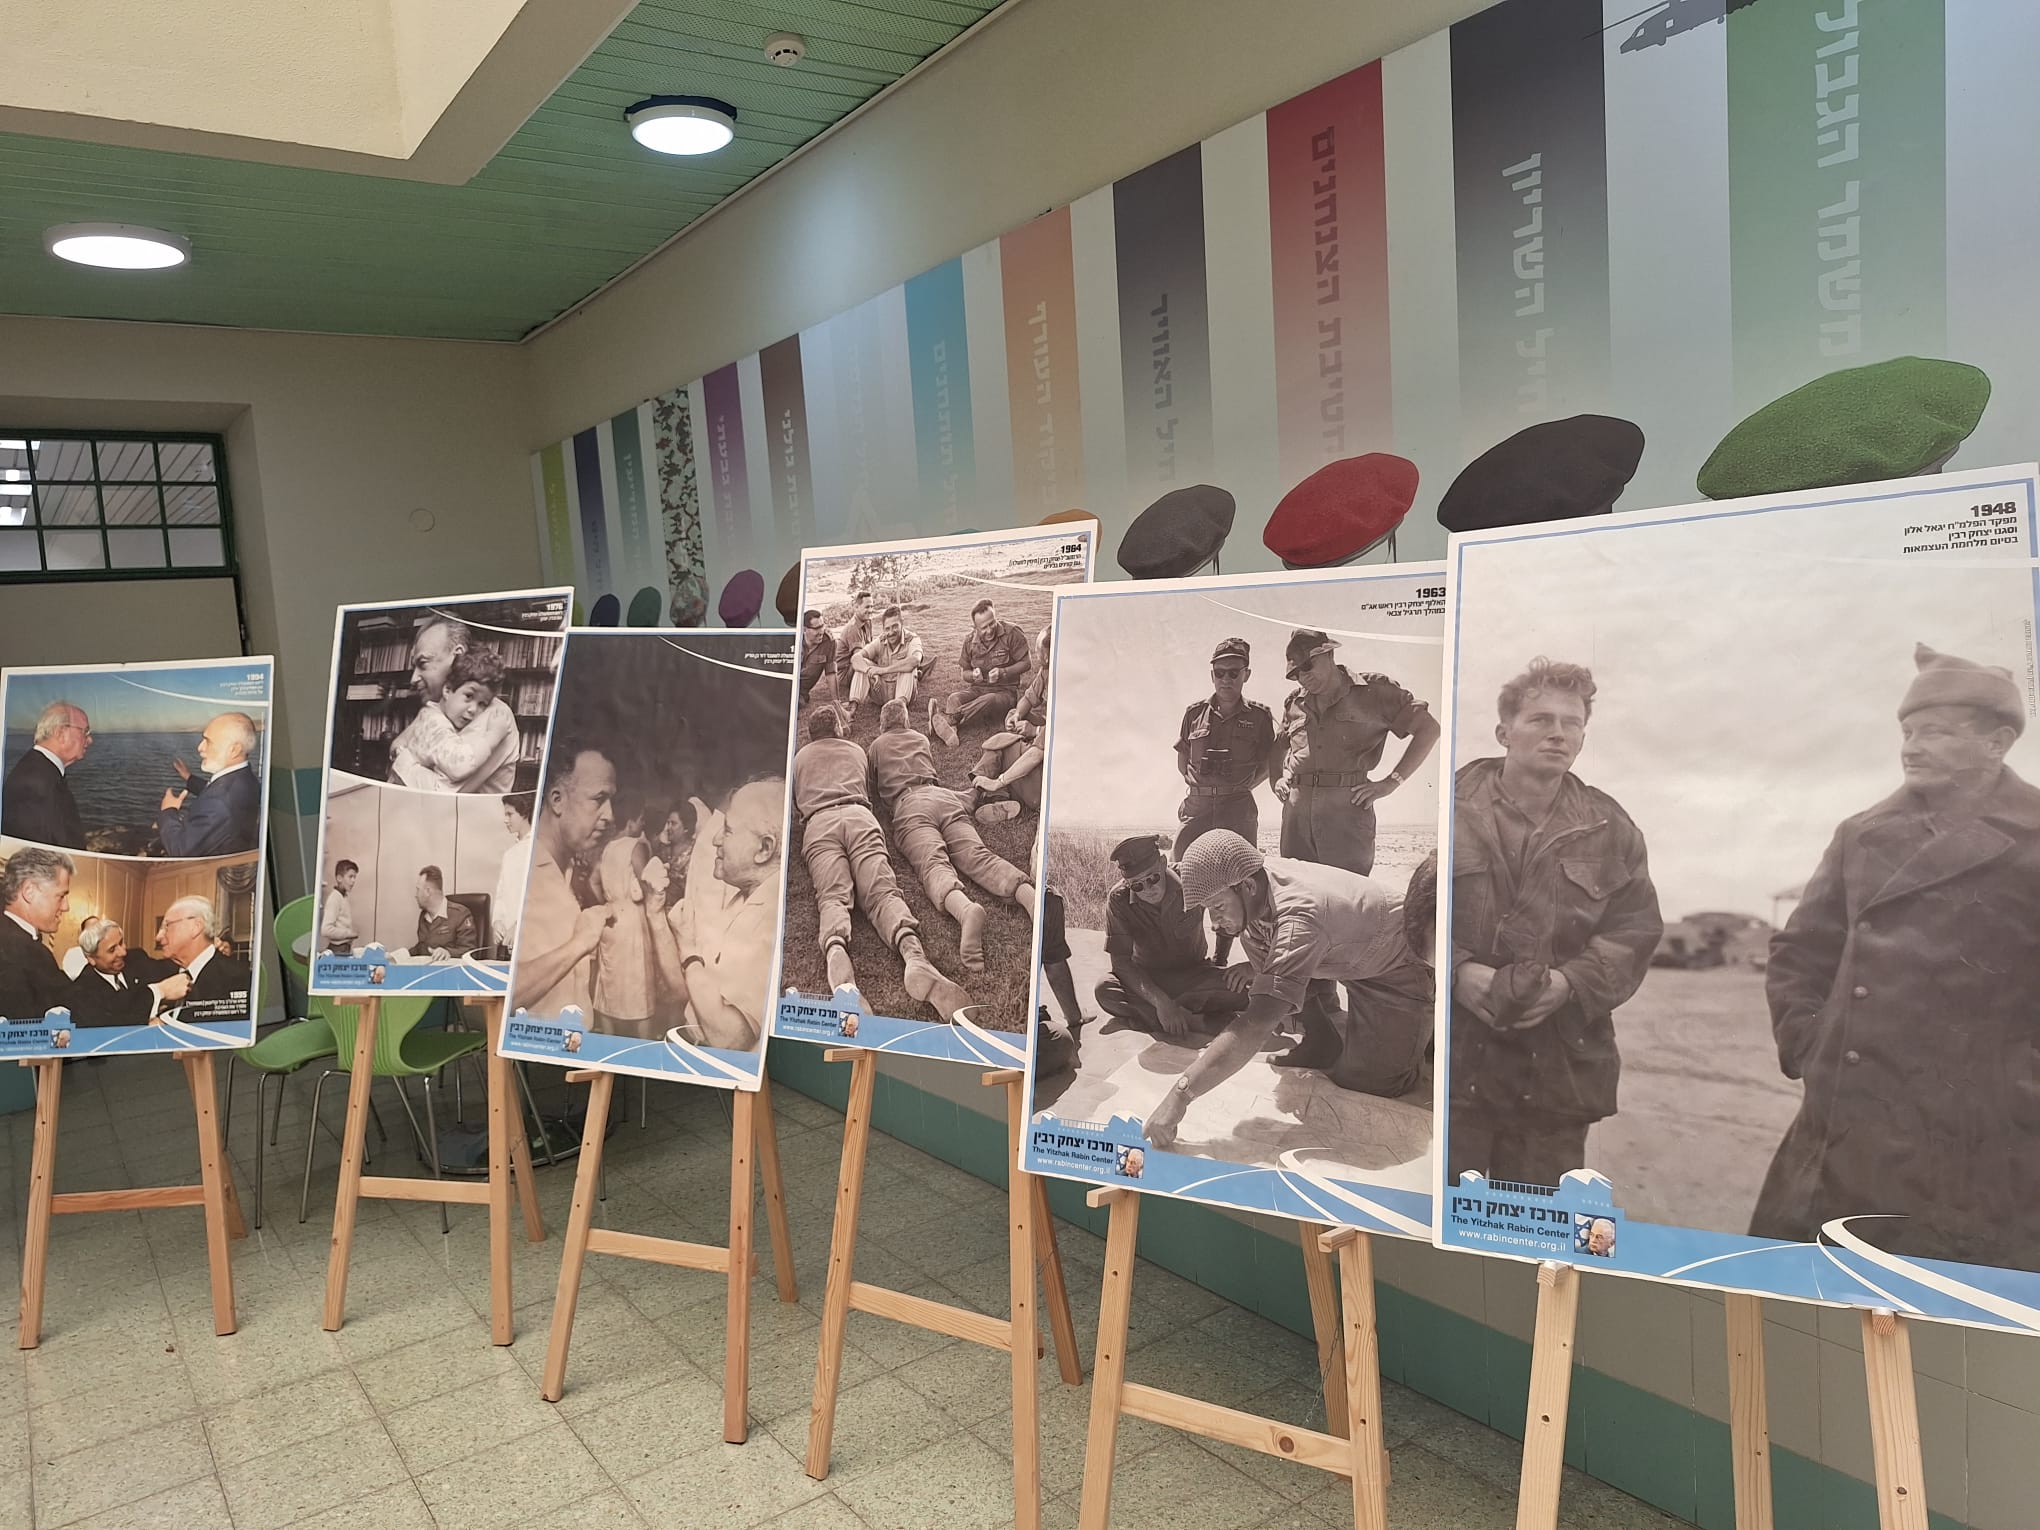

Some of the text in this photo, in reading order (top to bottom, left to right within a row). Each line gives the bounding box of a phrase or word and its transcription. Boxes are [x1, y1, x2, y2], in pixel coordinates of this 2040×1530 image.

[1817, 180, 1861, 356] משמר
[1311, 126, 1346, 453] חטיבת הצנחנים
[1502, 153, 1554, 413] חיל השריון
[1028, 301, 1050, 404] העורף
[1151, 294, 1178, 481] חיל האוויר
[781, 409, 799, 545] טיבת גולני
[1971, 502, 2016, 517] 1948
[1904, 516, 2016, 536] מפקד הפלמ"ח יגאל אלון
[1948, 526, 2018, 541] וסגנו יצחק רבין
[1061, 544, 1081, 553] 1964
[1903, 536, 2018, 553] בסיום מלחמת העצמאות
[1416, 587, 1446, 598] 1963
[1408, 601, 1424, 609] יצחק
[1425, 600, 1445, 609] האלוף
[781, 1004, 837, 1018] מרכז יצחק רבין
[510, 1023, 562, 1036] מרכז יצחק רבין
[1034, 1132, 1113, 1152] מרכז יצחק רבין
[1047, 1148, 1069, 1157] Yitzhak
[1071, 1152, 1089, 1160] Rabin
[1092, 1155, 1113, 1164] Center
[1453, 1197, 1568, 1224] מרכז יצחק רבין
[1451, 1215, 1569, 1239] The Yitzhak Rabin Center
[1459, 1229, 1566, 1252] www.rabincenter.org.il
